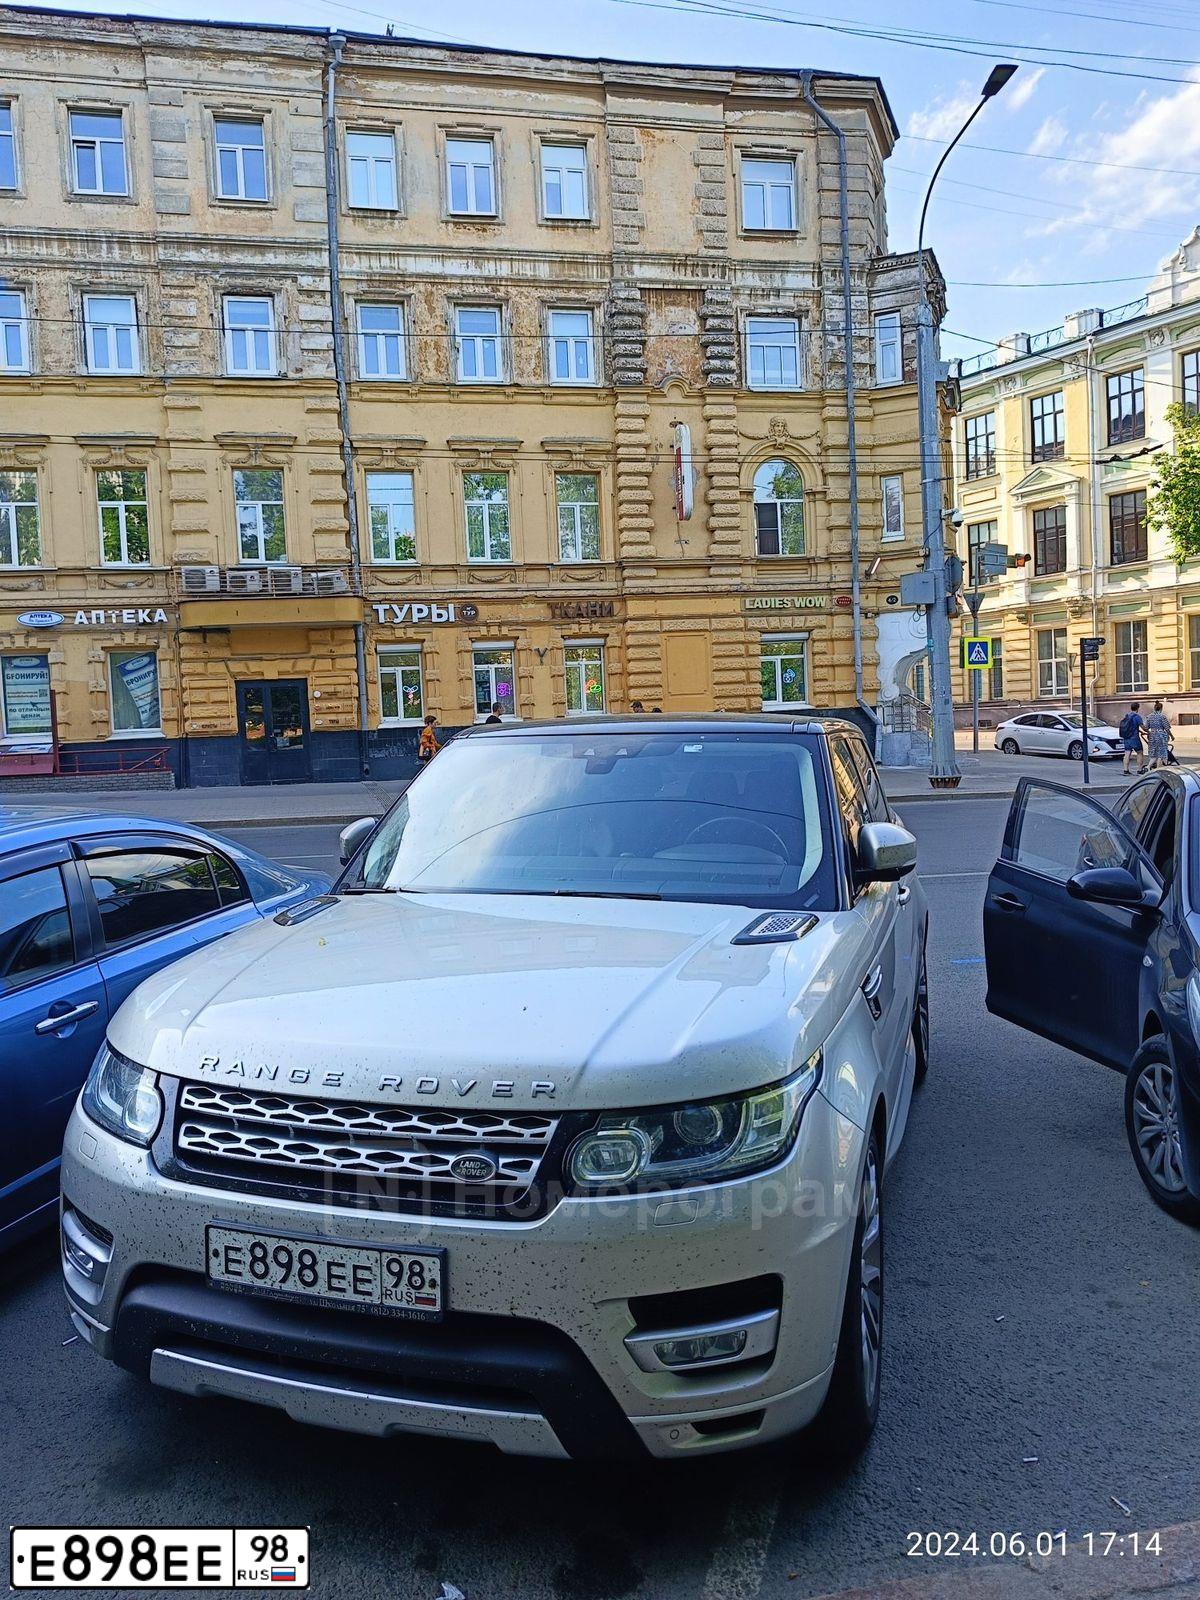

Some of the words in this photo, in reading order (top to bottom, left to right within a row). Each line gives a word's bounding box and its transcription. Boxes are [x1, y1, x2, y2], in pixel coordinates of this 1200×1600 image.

[547, 600, 615, 619] ТКАНИ
[745, 597, 791, 609] LADIES
[794, 596, 827, 608] WOW
[74, 608, 169, 626] АПТЕКА
[372, 603, 455, 624] ТУРЫ
[200, 1055, 345, 1088] RANGE
[378, 1074, 557, 1099] ROVER
[459, 1160, 481, 1169] LAND
[461, 1168, 487, 1176] ROVER
[386, 1257, 425, 1291] 98
[384, 1288, 414, 1303] RUS
